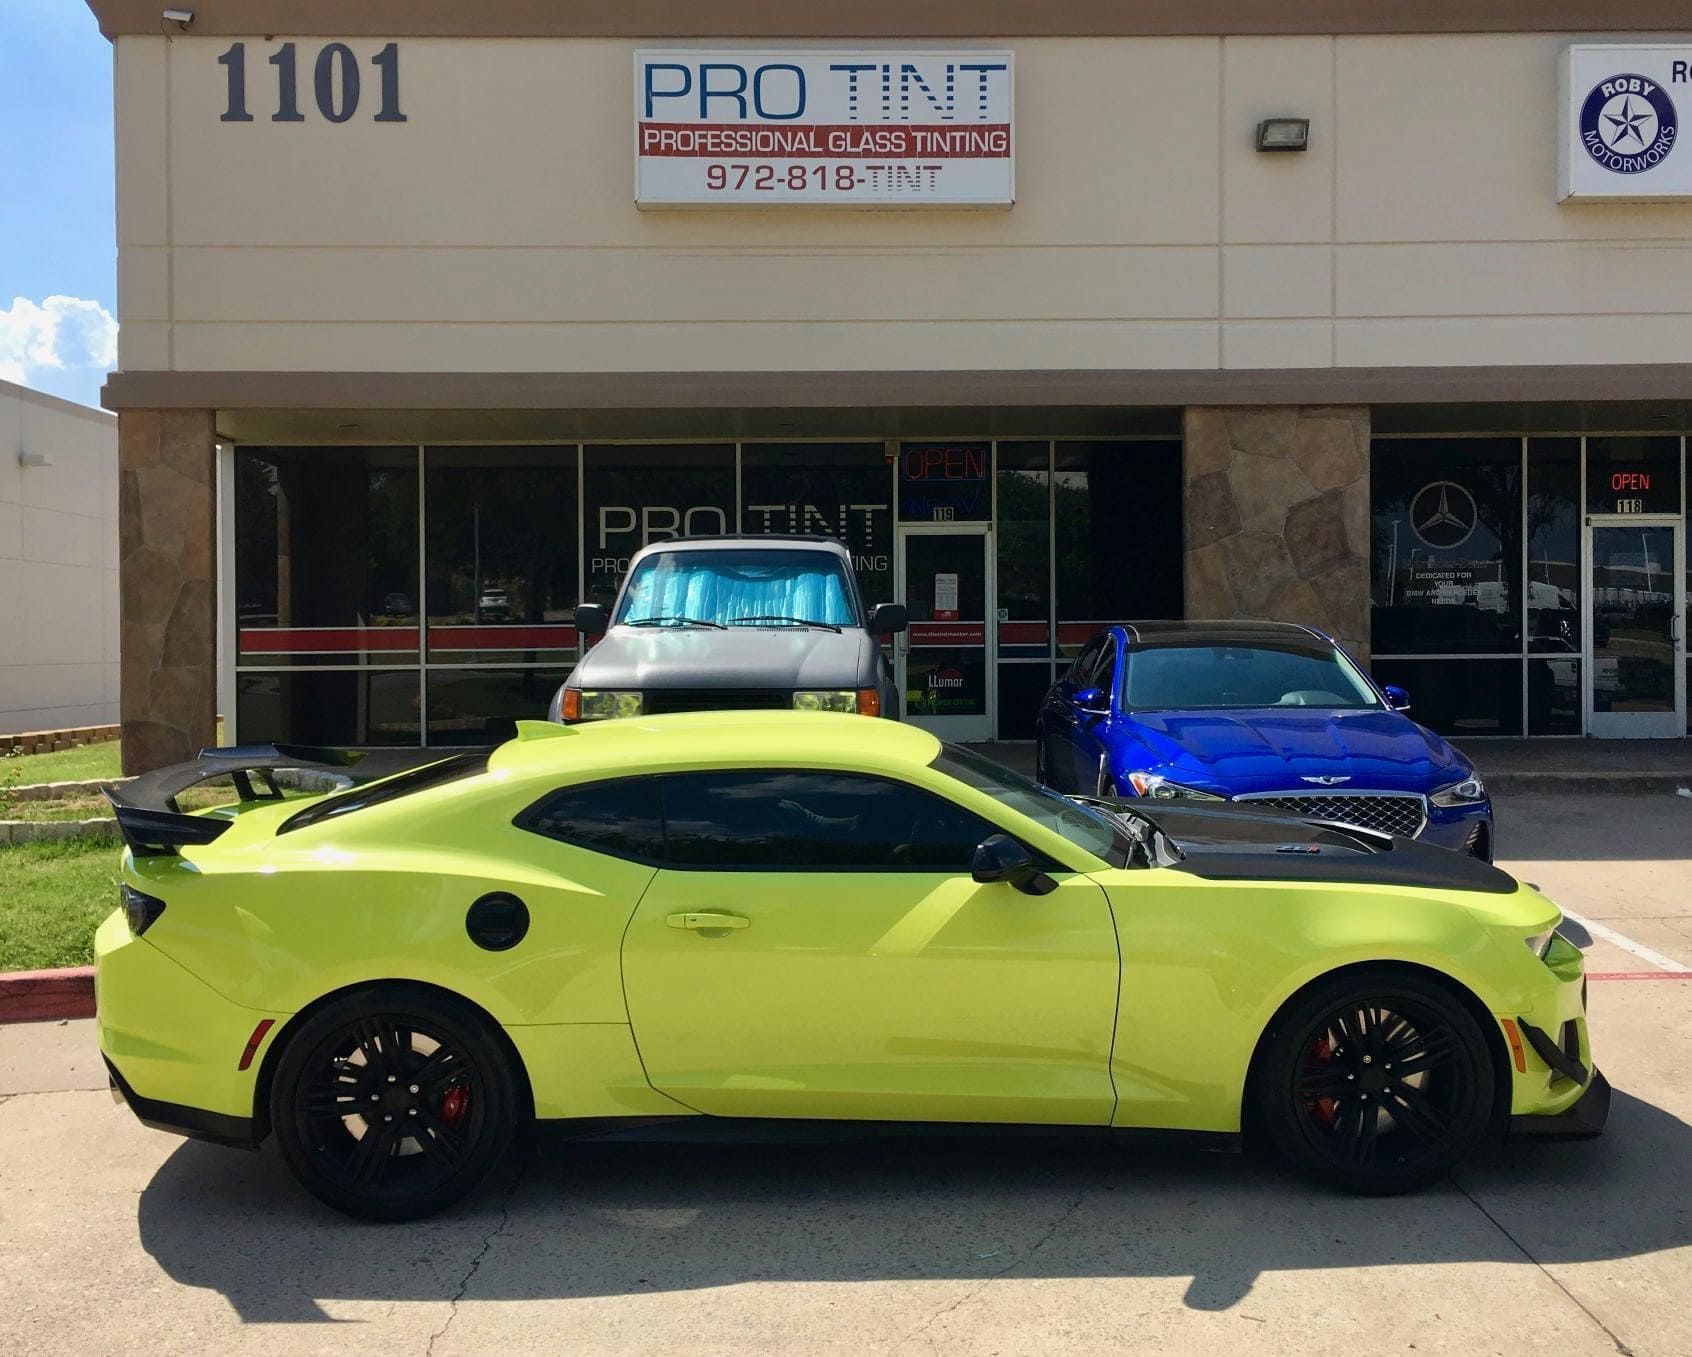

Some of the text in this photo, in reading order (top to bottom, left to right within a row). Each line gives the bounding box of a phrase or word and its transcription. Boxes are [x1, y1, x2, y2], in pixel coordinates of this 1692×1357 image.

[218, 42, 407, 123] 1101
[1672, 60, 1692, 83] R
[645, 63, 1007, 120] PRO TINT
[1601, 78, 1656, 97] ROBY
[643, 129, 1007, 153] PROFESSIONAL GLASS TINTING
[1584, 126, 1674, 171] MOTORWORKS
[706, 164, 943, 192] 972-818-TINT
[905, 447, 984, 480] OPEN
[1611, 473, 1650, 491] OPEN
[934, 508, 953, 521] 119
[1618, 500, 1642, 513] 118
[599, 504, 888, 549] PRO TINT
[1415, 571, 1472, 580] DEDICATED FOR
[1434, 580, 1454, 588] YOUR
[928, 674, 964, 688] LLumar
